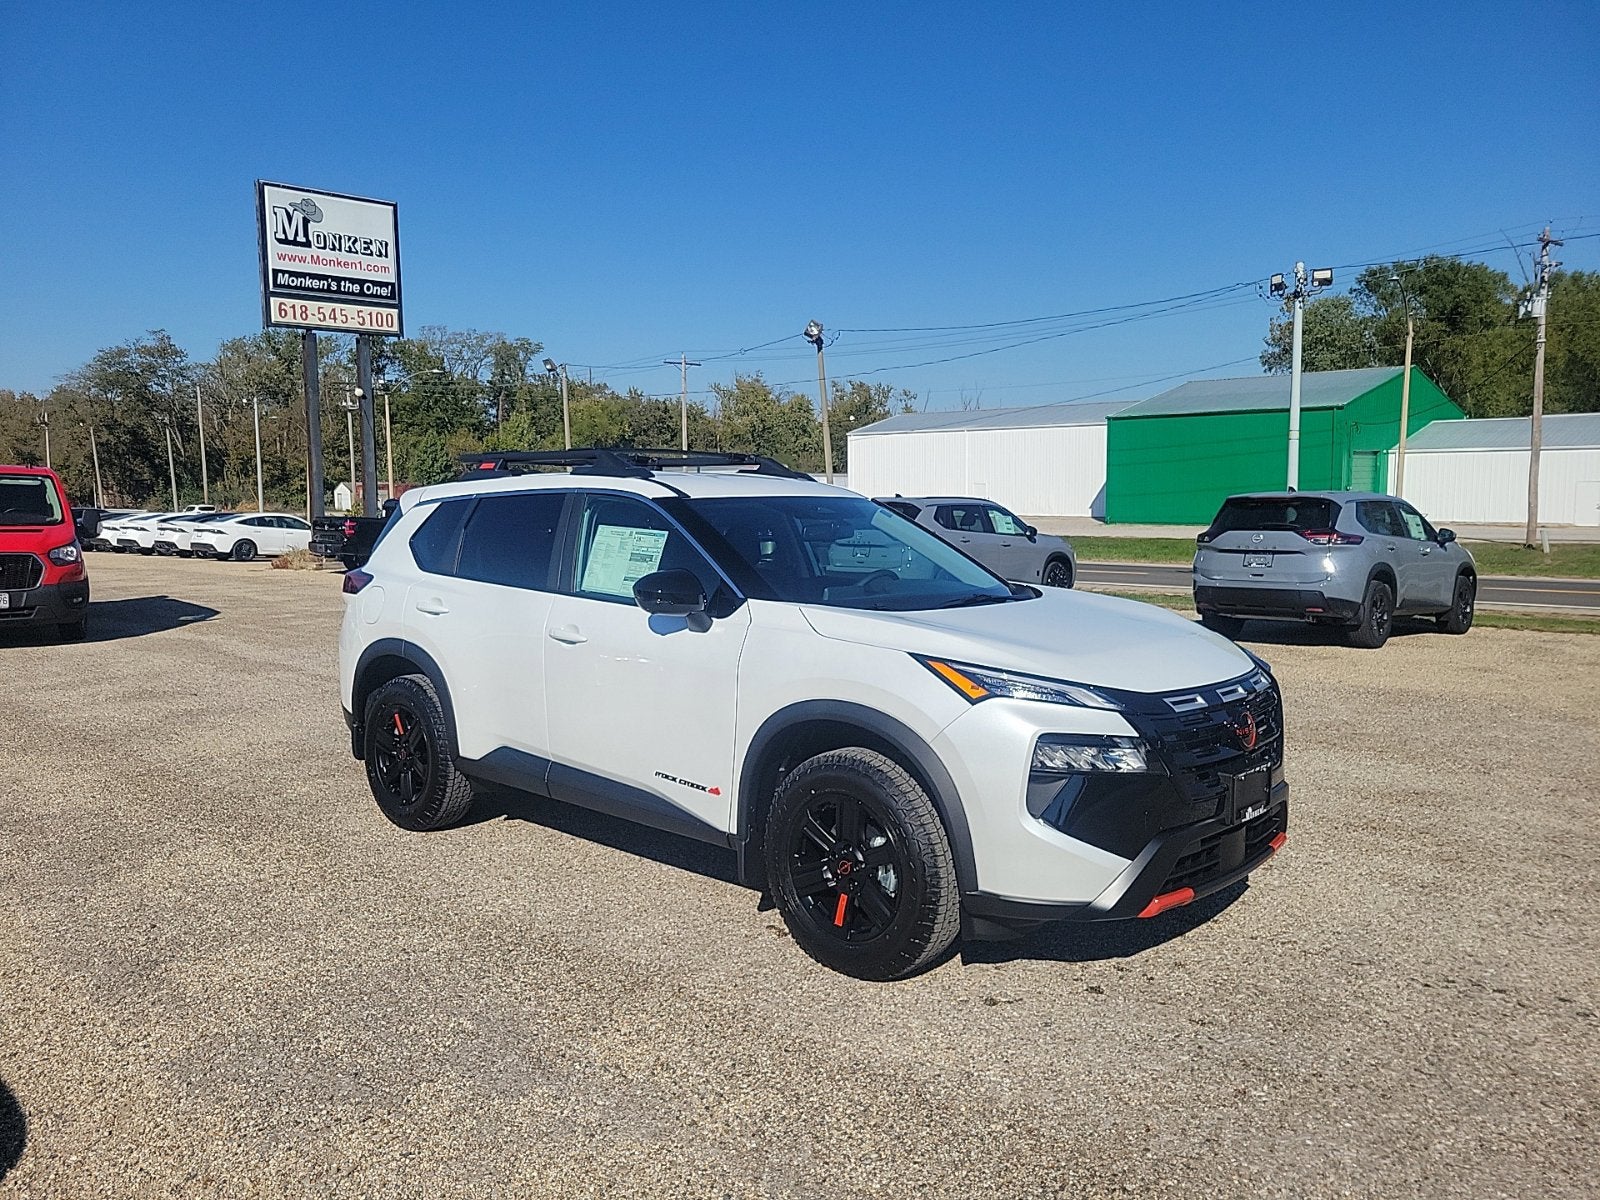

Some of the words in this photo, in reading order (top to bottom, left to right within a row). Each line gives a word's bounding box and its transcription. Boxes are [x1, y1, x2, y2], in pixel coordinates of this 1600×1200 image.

[273, 206, 389, 259] MONKEN
[276, 251, 390, 274] www.Monken1.com
[277, 272, 338, 290] Monken's
[340, 280, 360, 293] the
[364, 283, 391, 297] One!
[278, 302, 394, 328] 618-545-5100
